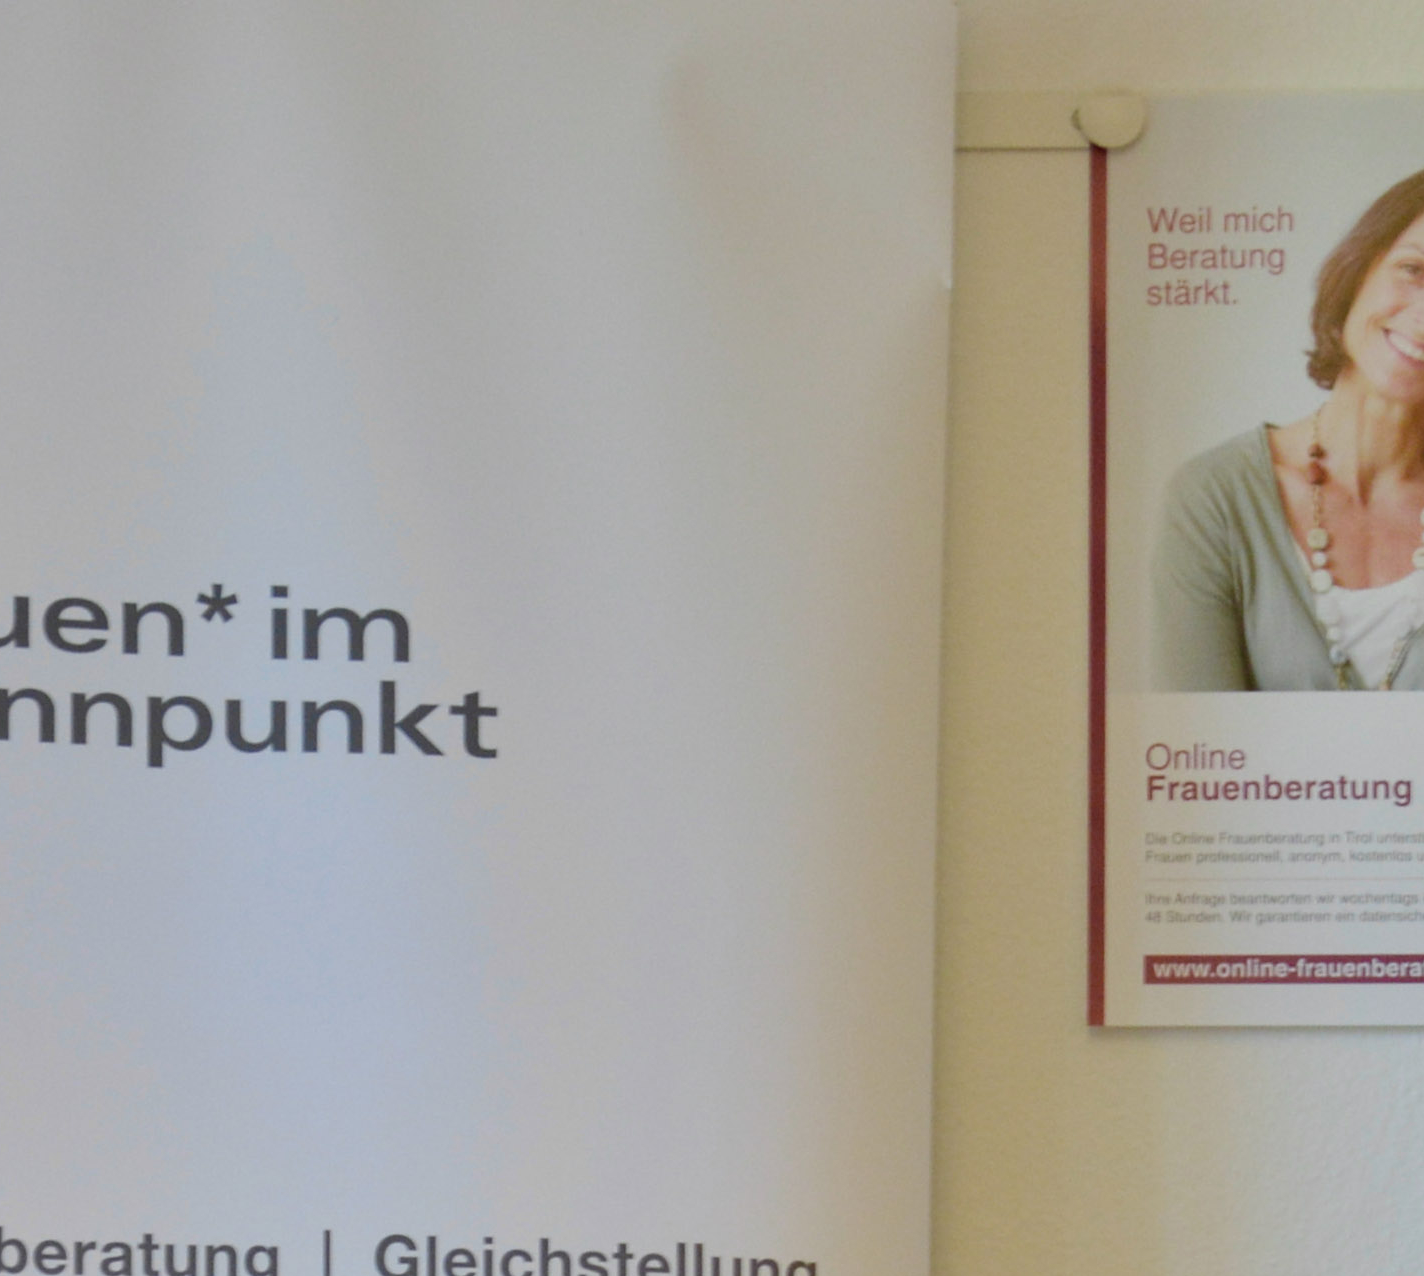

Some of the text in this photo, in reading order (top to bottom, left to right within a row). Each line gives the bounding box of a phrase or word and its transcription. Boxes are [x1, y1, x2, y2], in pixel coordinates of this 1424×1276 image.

[1147, 205, 1295, 234] Weil mich
[1147, 243, 1285, 275] Beratung
[1146, 278, 1238, 306] stärkt.
[267, 585, 412, 662] im
[1145, 743, 1246, 771] Online
[1146, 775, 1413, 806] Frauenberatung
